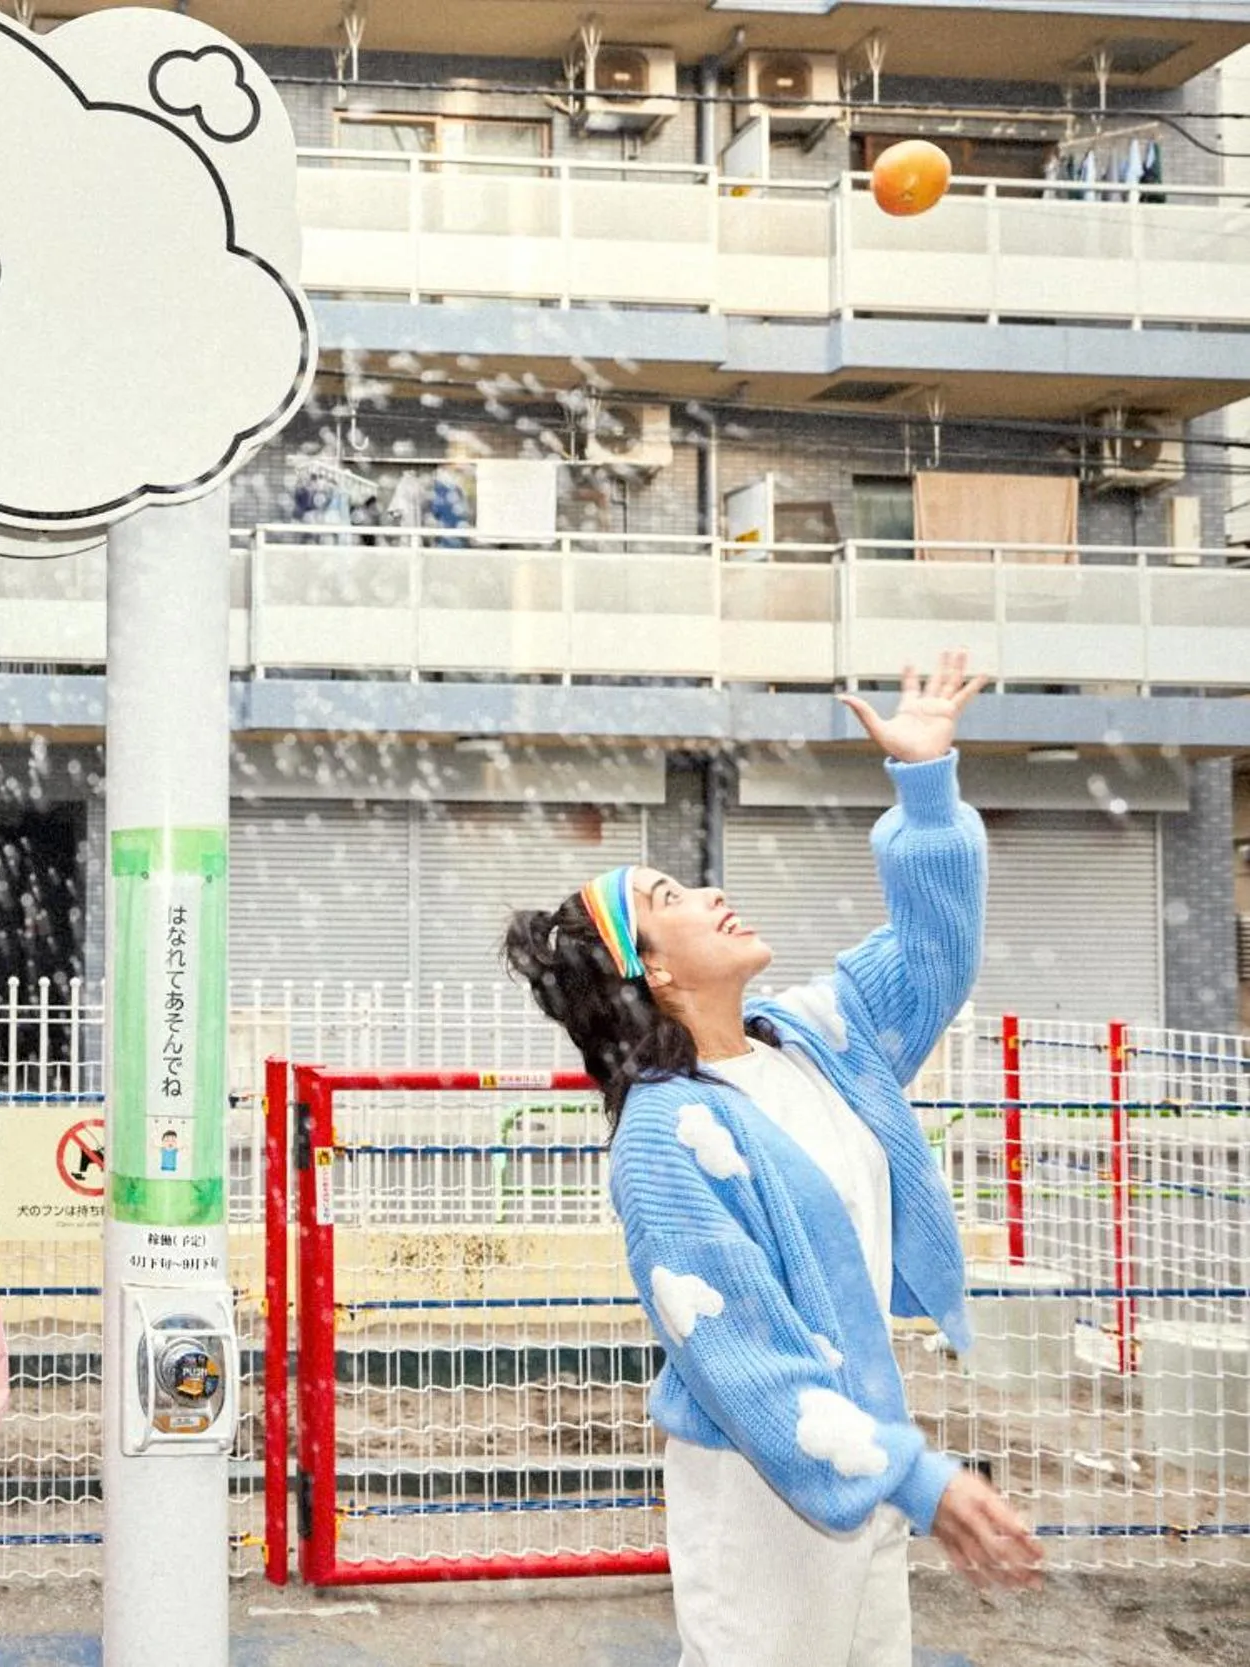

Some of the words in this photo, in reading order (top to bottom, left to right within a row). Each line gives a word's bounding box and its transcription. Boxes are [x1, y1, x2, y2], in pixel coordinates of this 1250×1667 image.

[162, 905, 188, 1098] はなれてあそんでね
